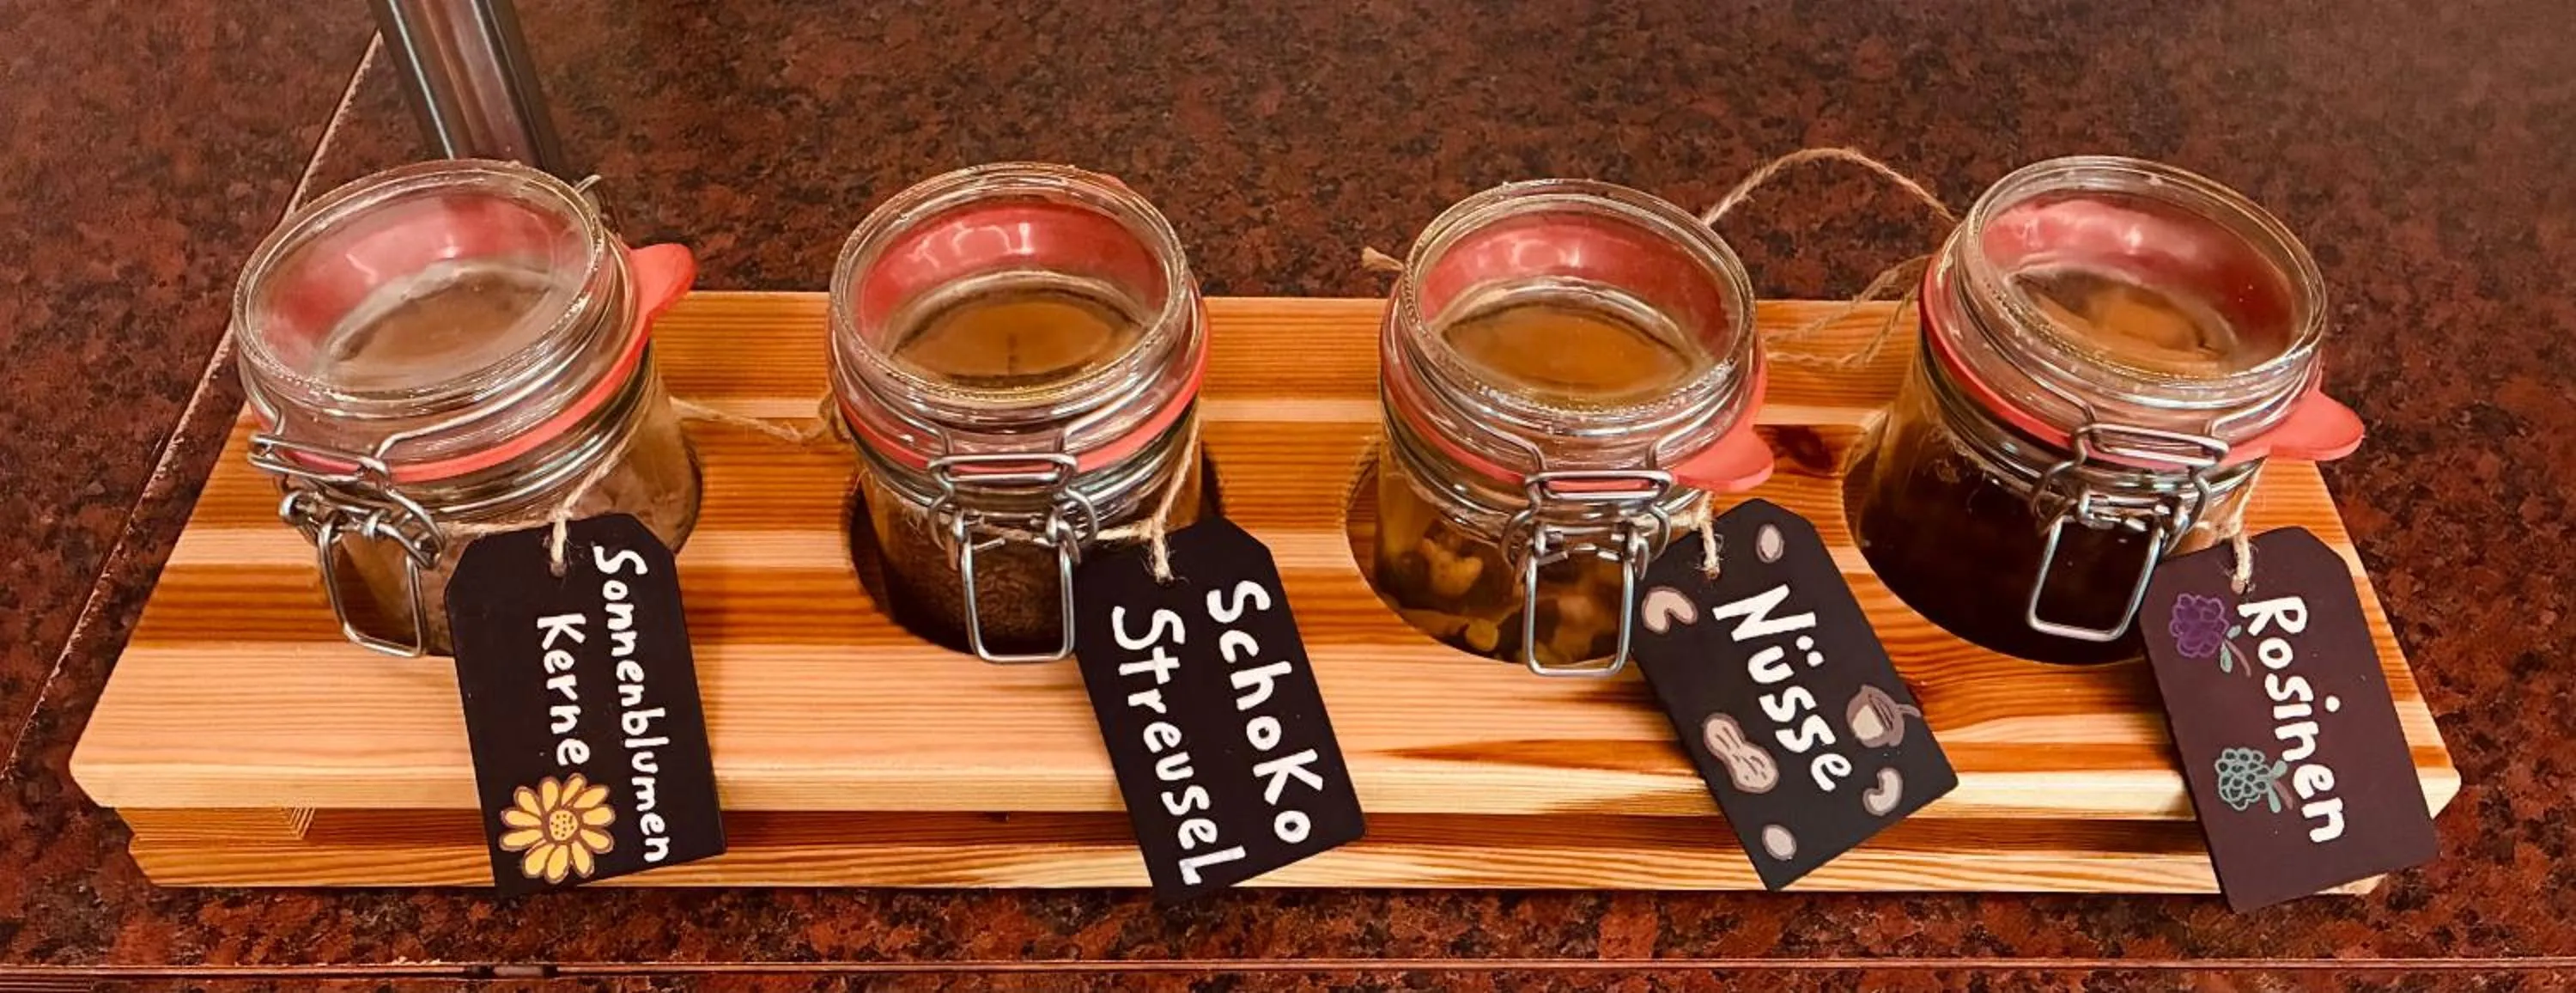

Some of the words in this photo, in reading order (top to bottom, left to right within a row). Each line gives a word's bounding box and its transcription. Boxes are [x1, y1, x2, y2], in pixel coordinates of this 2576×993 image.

[537, 612, 591, 766] Kerne
[592, 542, 671, 862] Sonnenblumen
[1711, 584, 1852, 792] Nüsse
[2237, 595, 2346, 844] Rosinen
